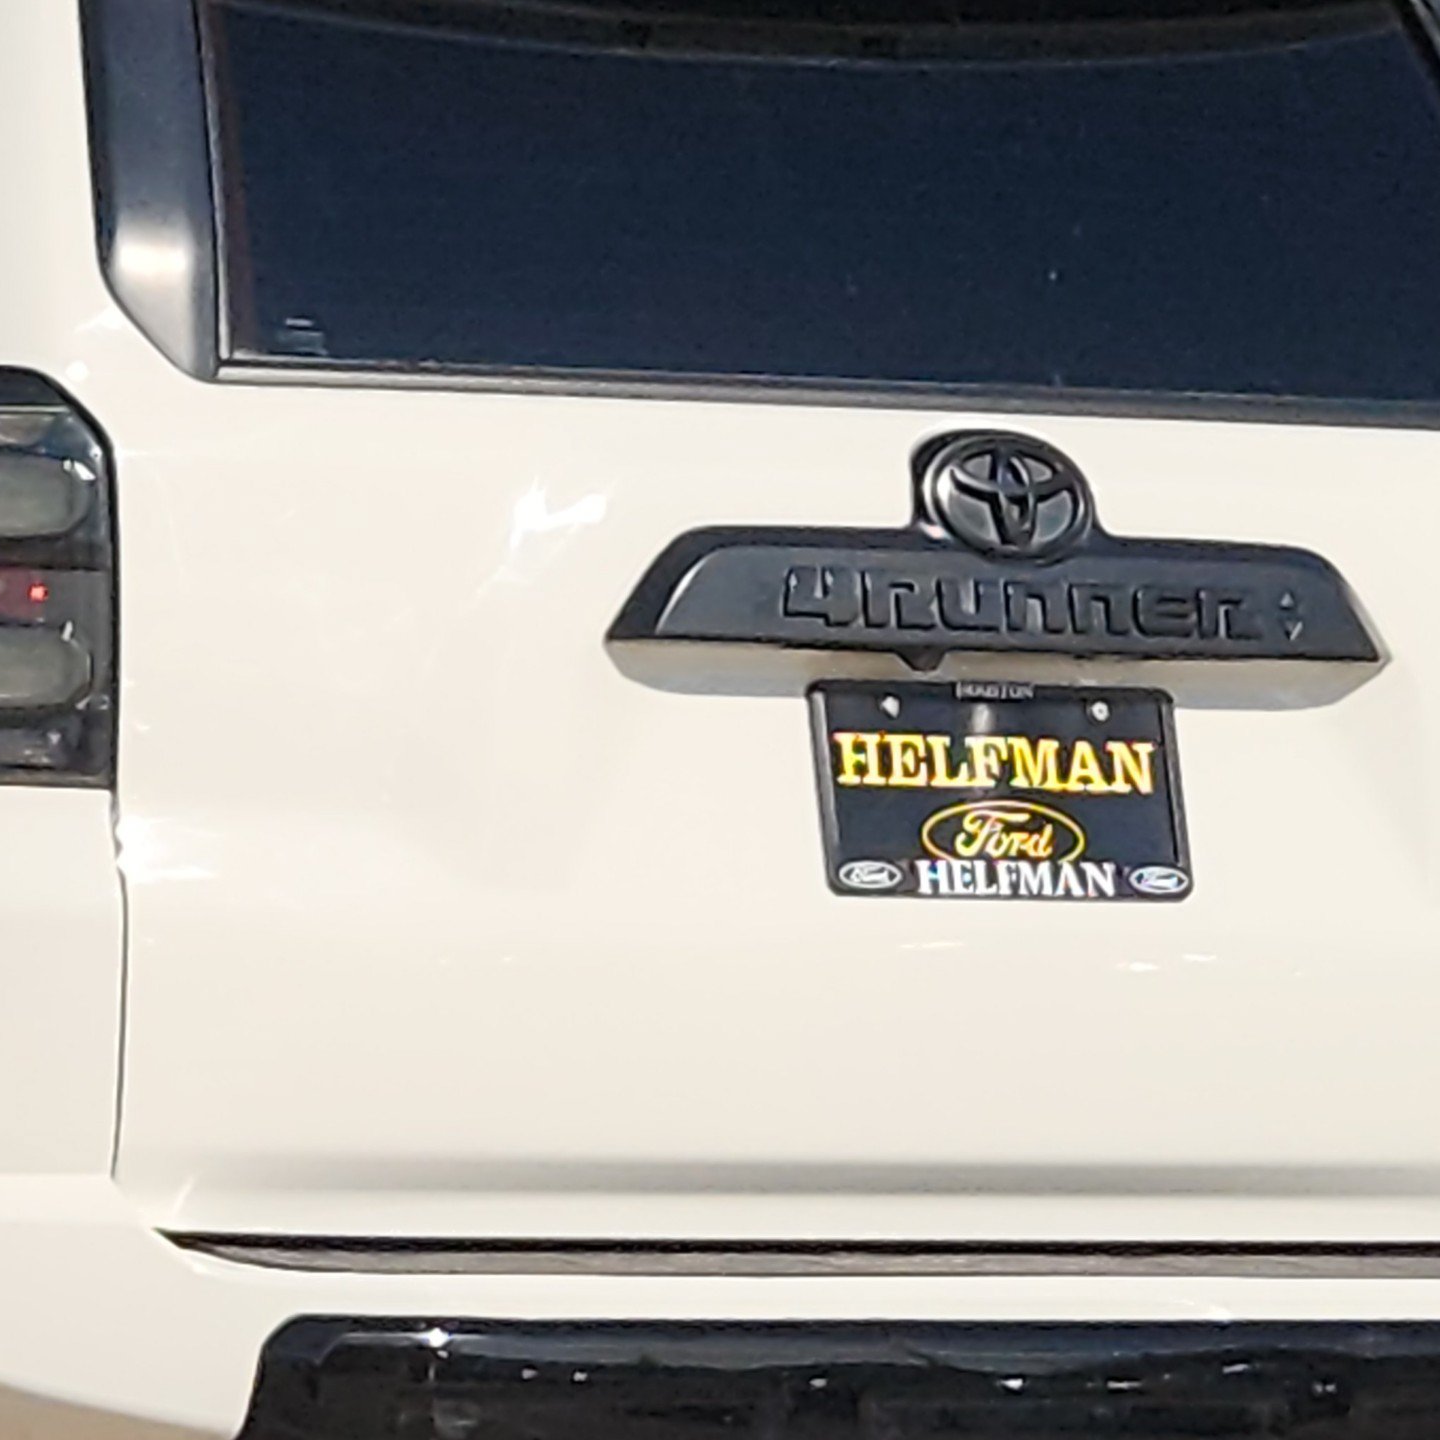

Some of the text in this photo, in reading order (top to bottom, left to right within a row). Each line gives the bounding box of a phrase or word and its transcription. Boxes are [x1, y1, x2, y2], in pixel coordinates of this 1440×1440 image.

[833, 731, 1157, 795] HELFMAN
[954, 808, 1055, 859] Ford
[915, 860, 1118, 898] HELFMAN
